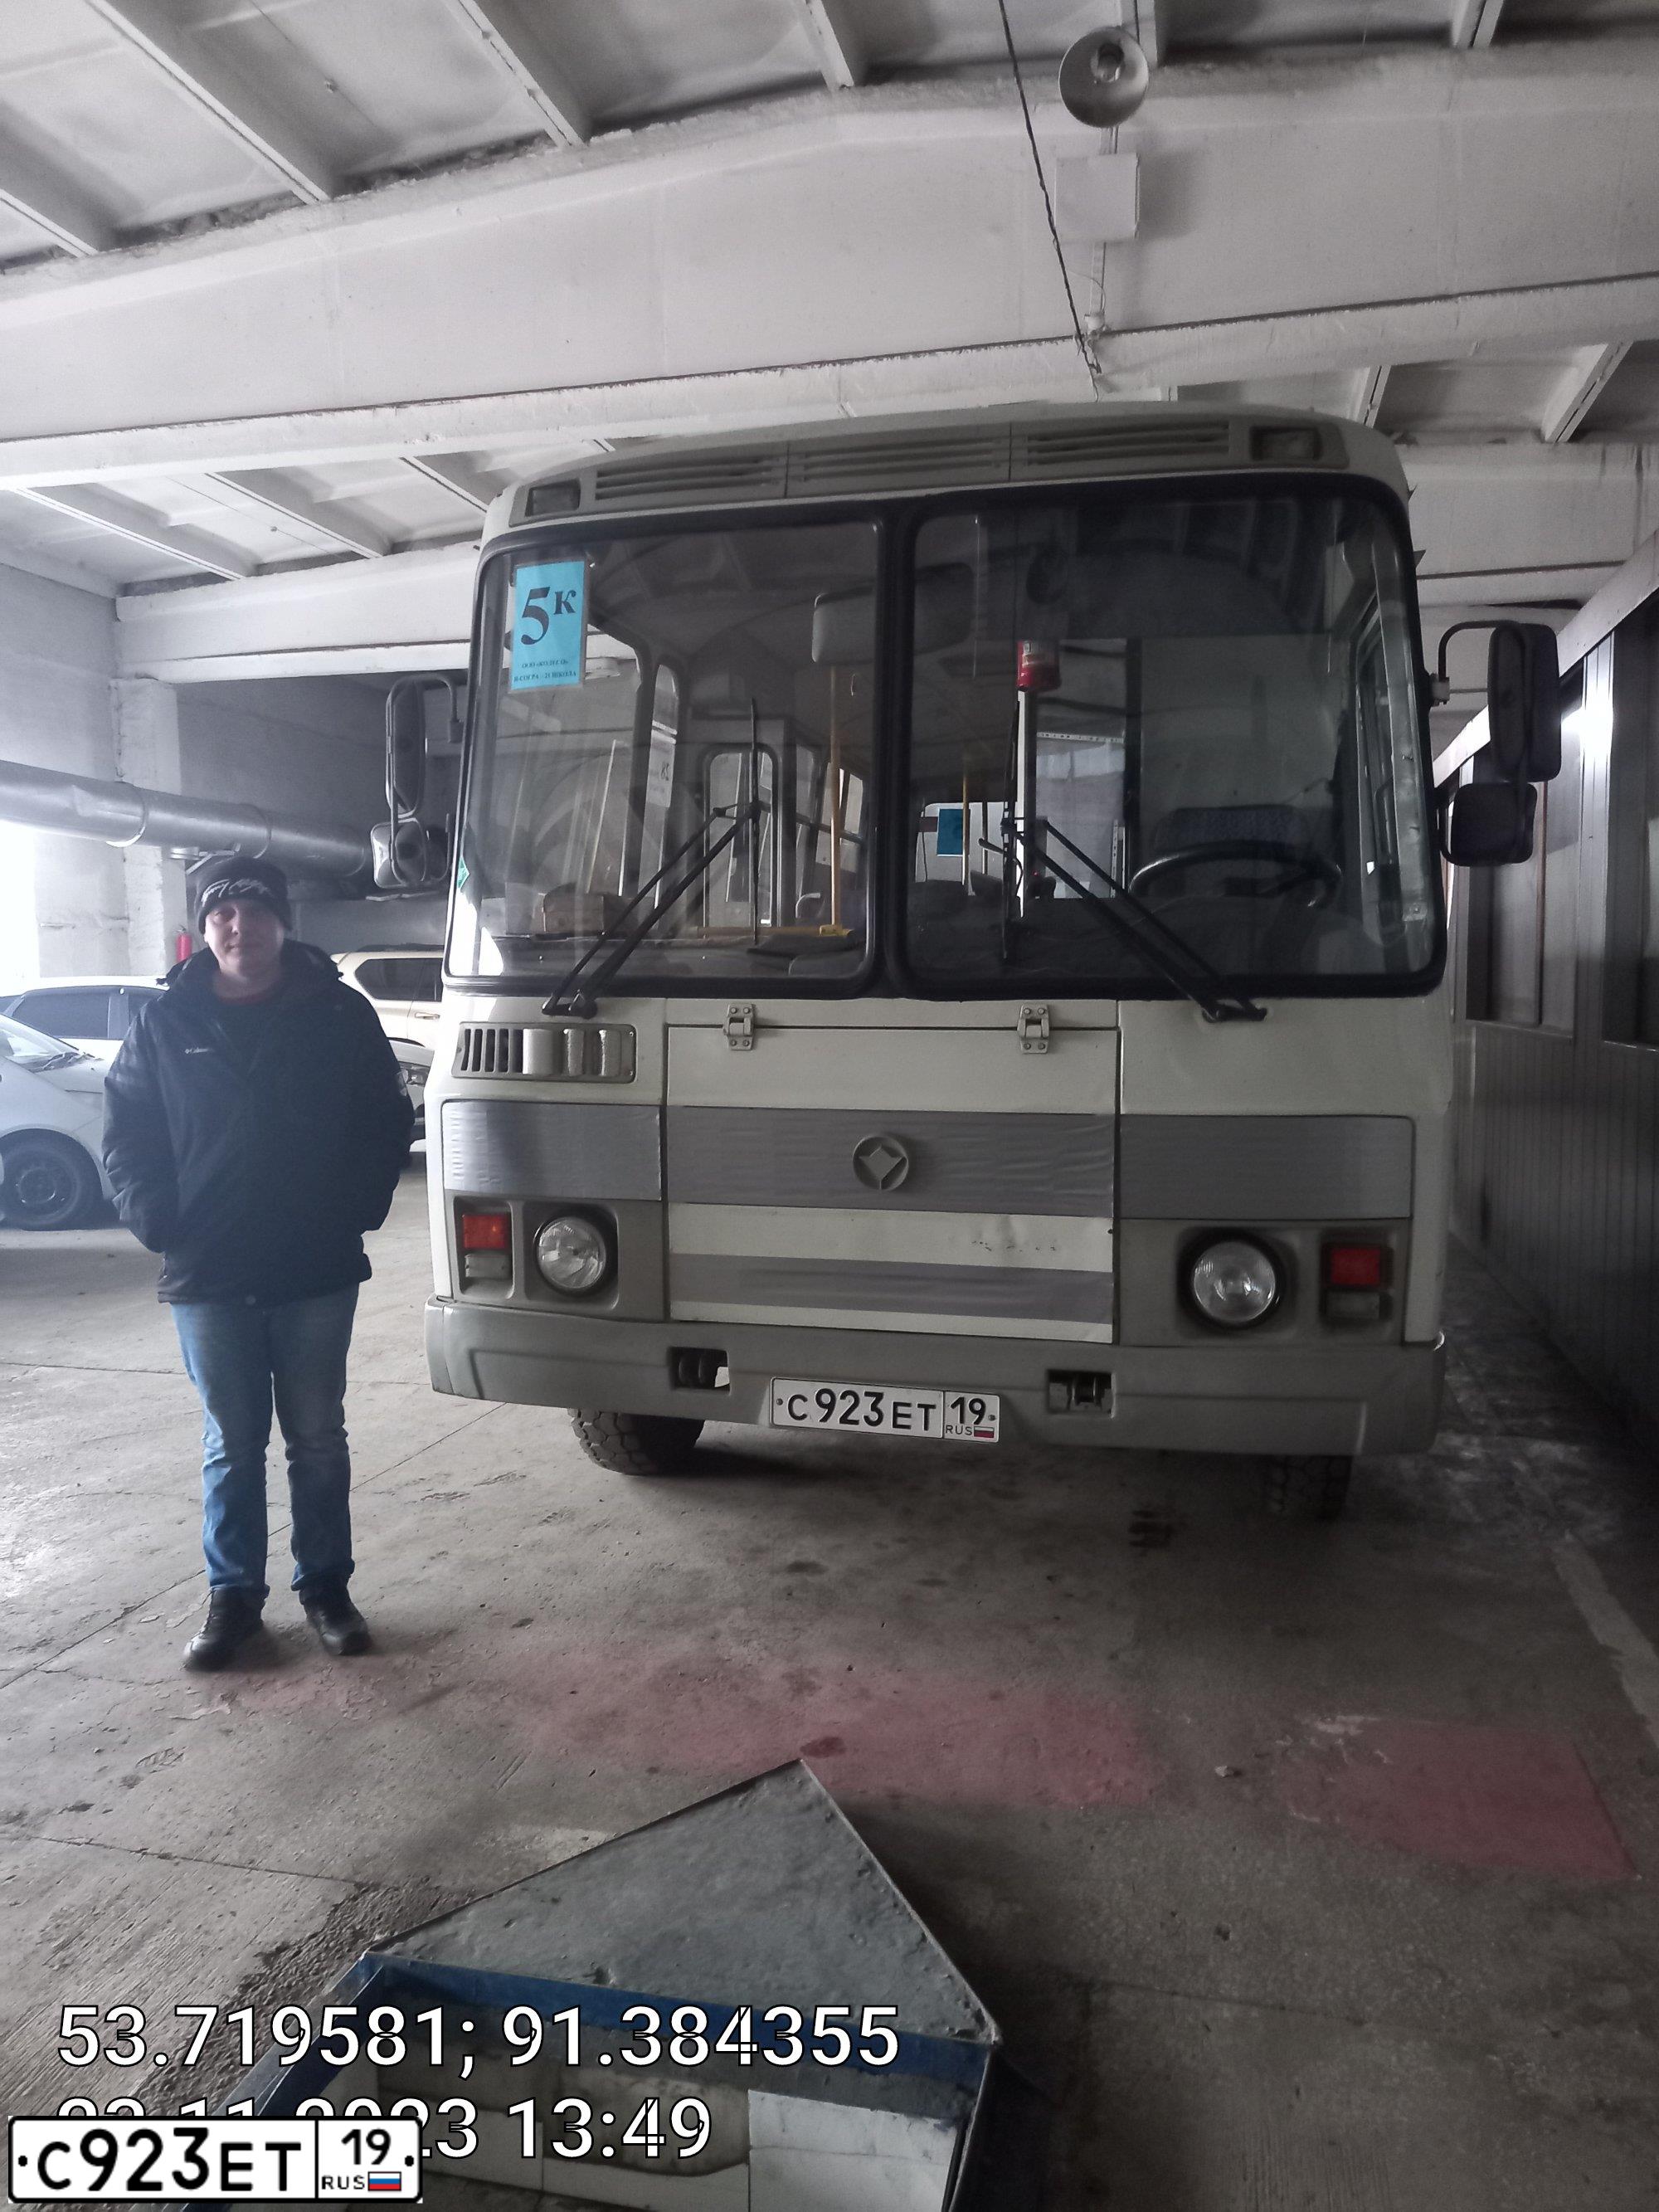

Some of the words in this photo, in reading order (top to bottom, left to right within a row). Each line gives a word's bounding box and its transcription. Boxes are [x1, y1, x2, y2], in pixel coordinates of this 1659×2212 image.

[787, 1388, 937, 1431] С923ЕТ
[950, 1396, 986, 1425] 19
[945, 1425, 973, 1436] RUS
